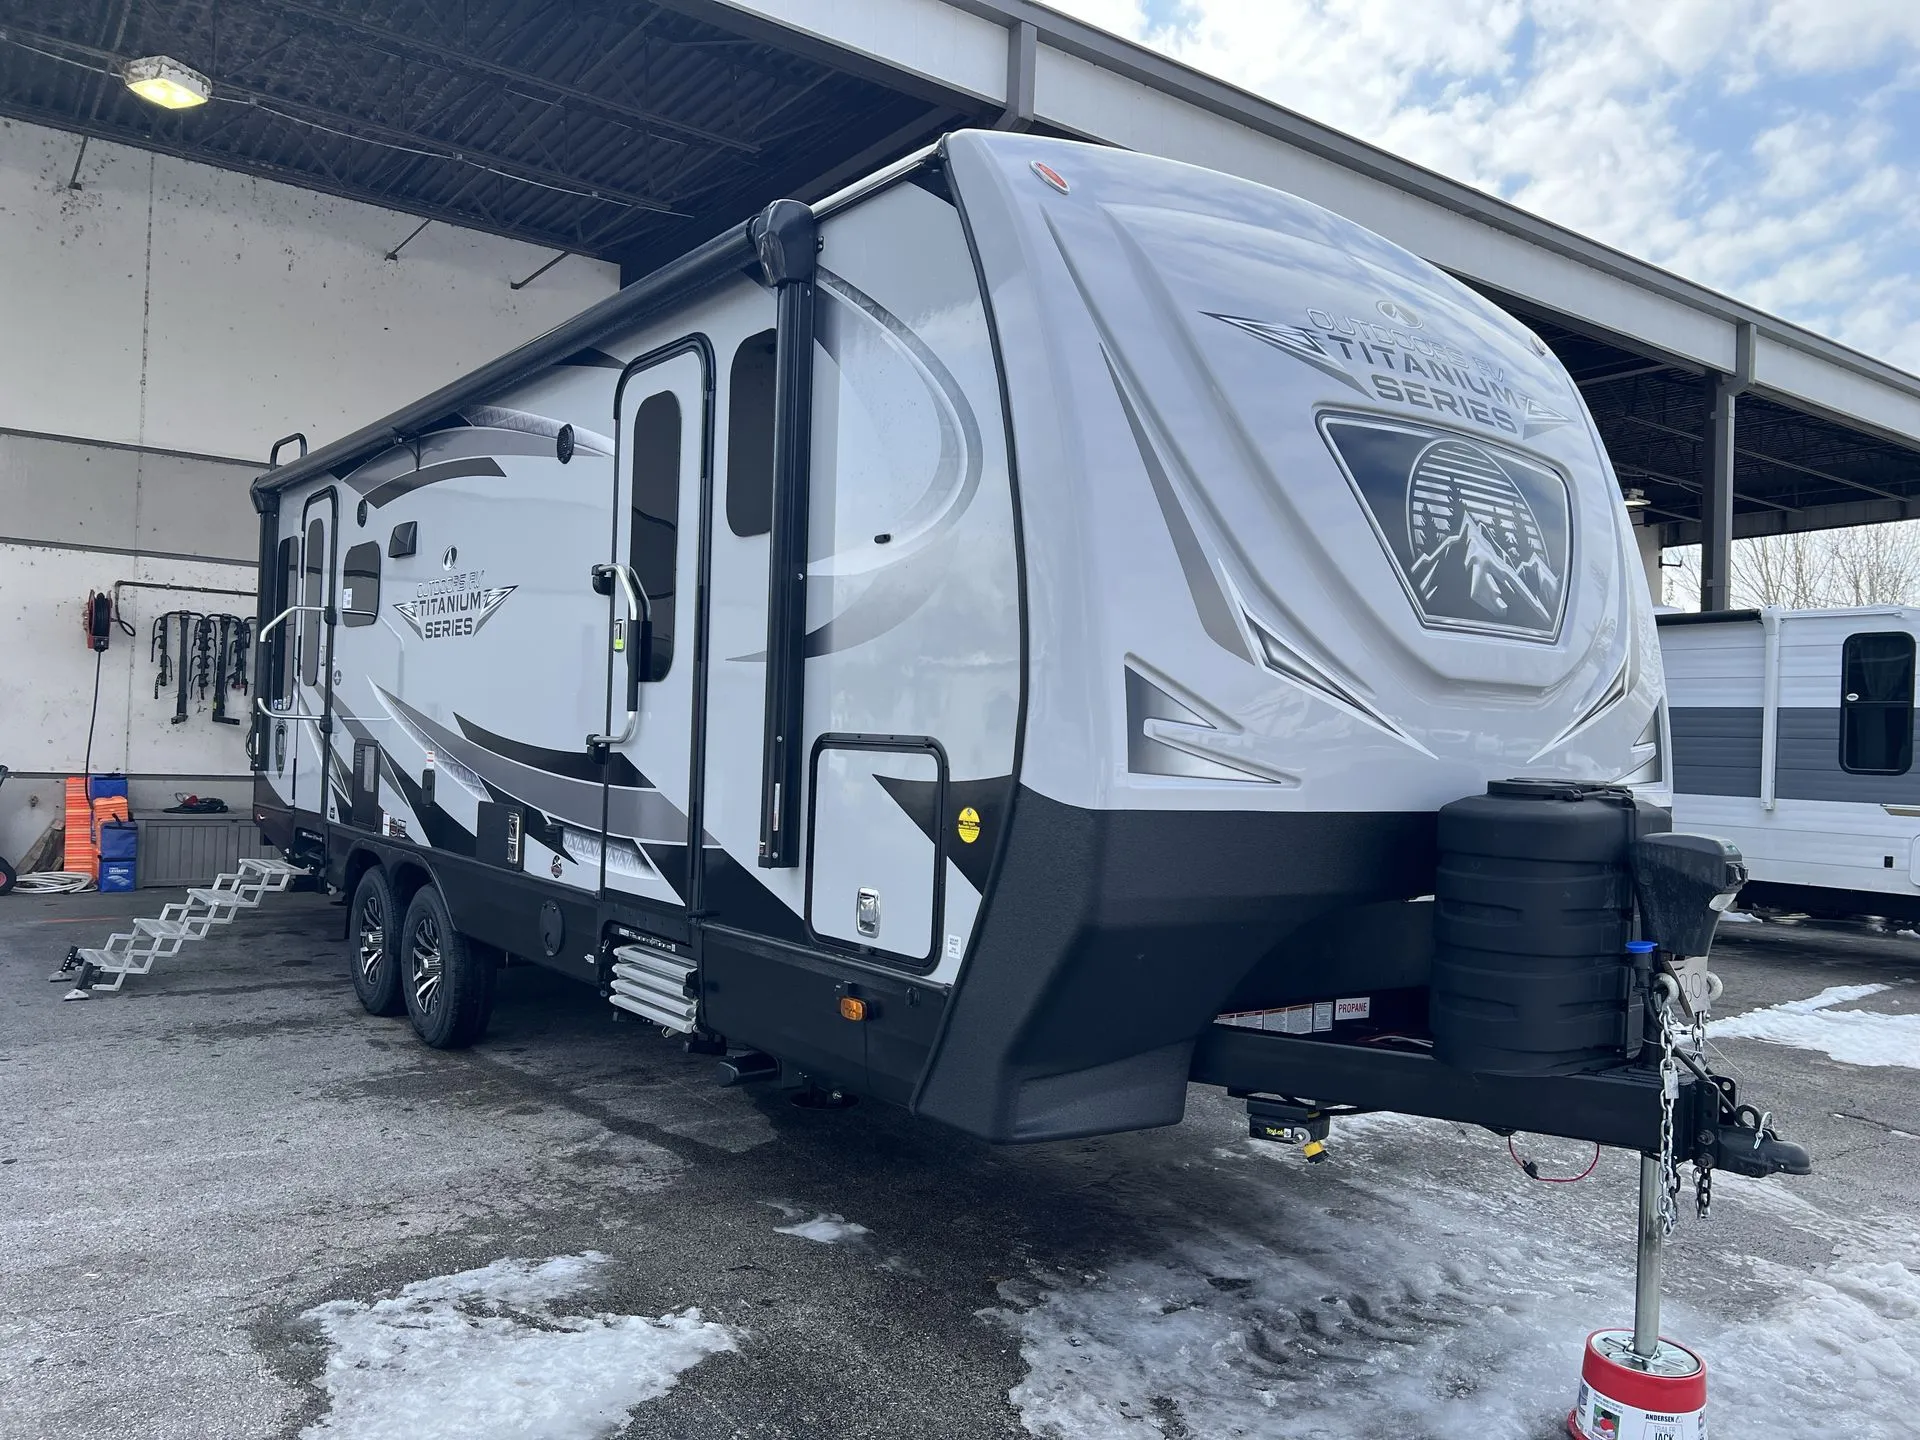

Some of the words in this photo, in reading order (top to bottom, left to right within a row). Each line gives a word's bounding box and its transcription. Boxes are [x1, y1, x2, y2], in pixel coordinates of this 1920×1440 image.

[1306, 307, 1468, 369] OUTDOORS
[1326, 334, 1520, 410] TITANIUM
[1371, 374, 1518, 434] SERIES
[416, 573, 467, 599] OUTDOORS
[419, 591, 481, 617] TITANIUM
[425, 617, 473, 639] SERIES
[1338, 1001, 1368, 1014] PROPANE
[1645, 1413, 1675, 1423] ANDERSEN
[1654, 1425, 1676, 1433] TRAILER
[1655, 1432, 1675, 1440] JACK
